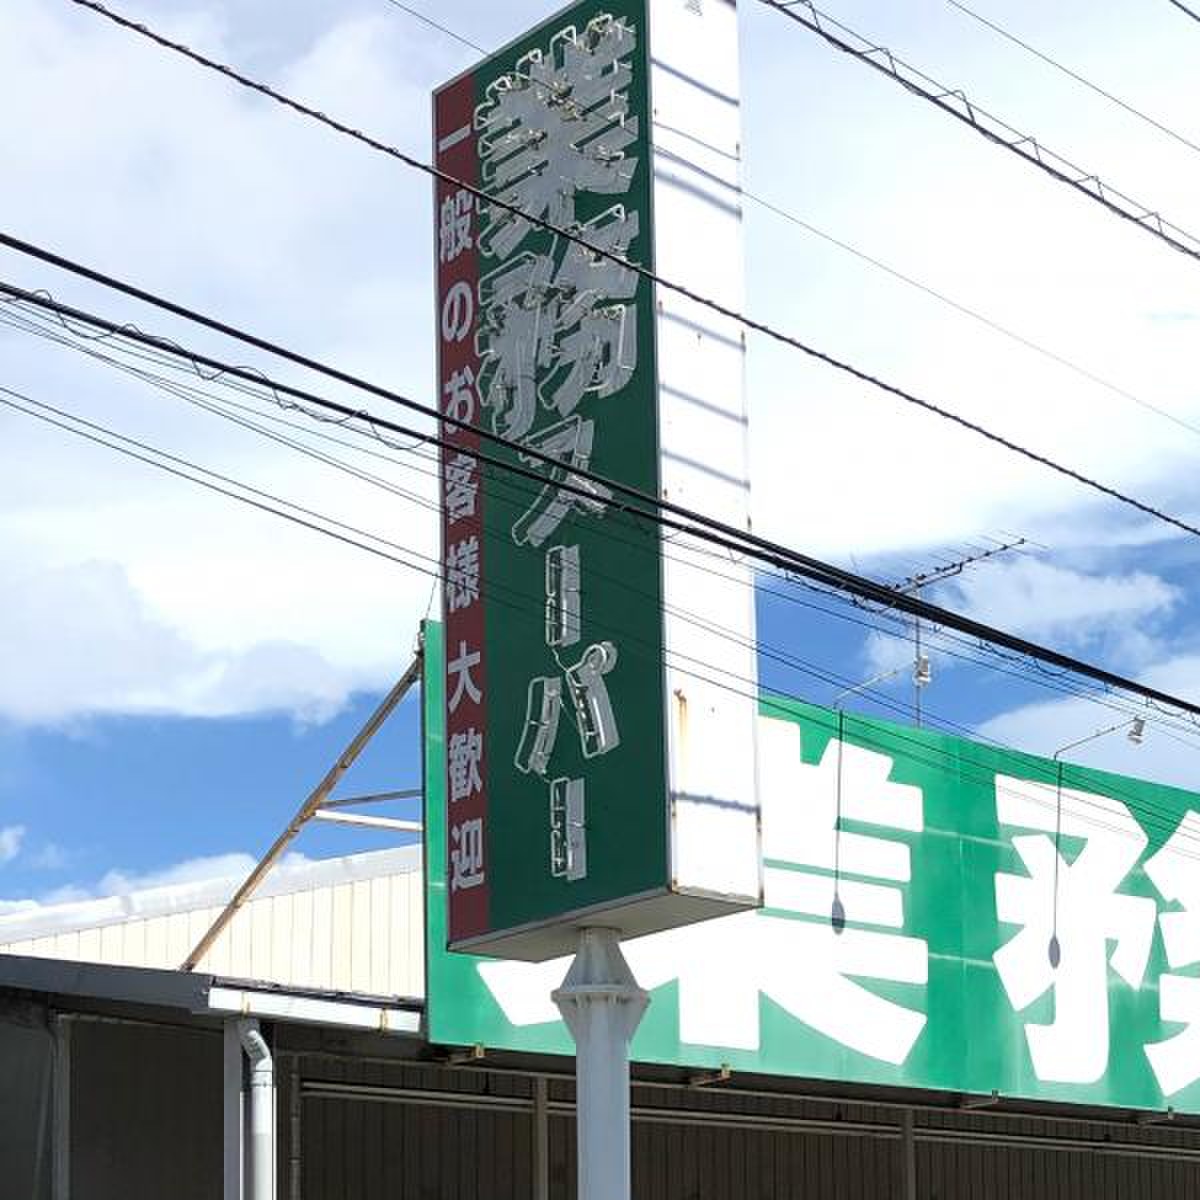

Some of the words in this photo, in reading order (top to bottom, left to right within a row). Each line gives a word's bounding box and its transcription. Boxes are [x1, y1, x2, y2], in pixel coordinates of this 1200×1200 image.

[437, 124, 485, 892] 一般のお客様大歓迎
[474, 13, 638, 881] 業務スーパー
